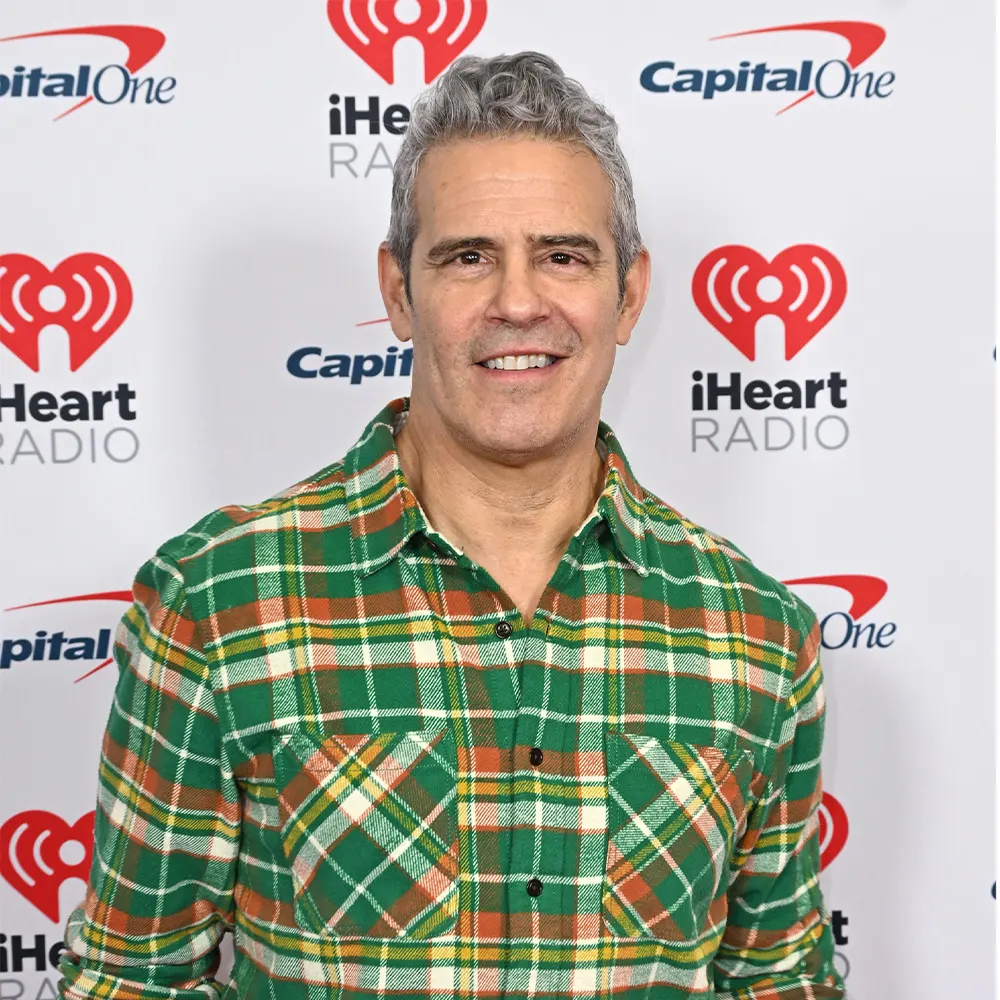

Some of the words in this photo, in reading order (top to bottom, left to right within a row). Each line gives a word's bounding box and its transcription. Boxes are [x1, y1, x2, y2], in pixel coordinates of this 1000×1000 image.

[691, 370, 847, 411] iHeart
[0, 427, 140, 465] ADIO
[691, 415, 849, 452] RADIO
